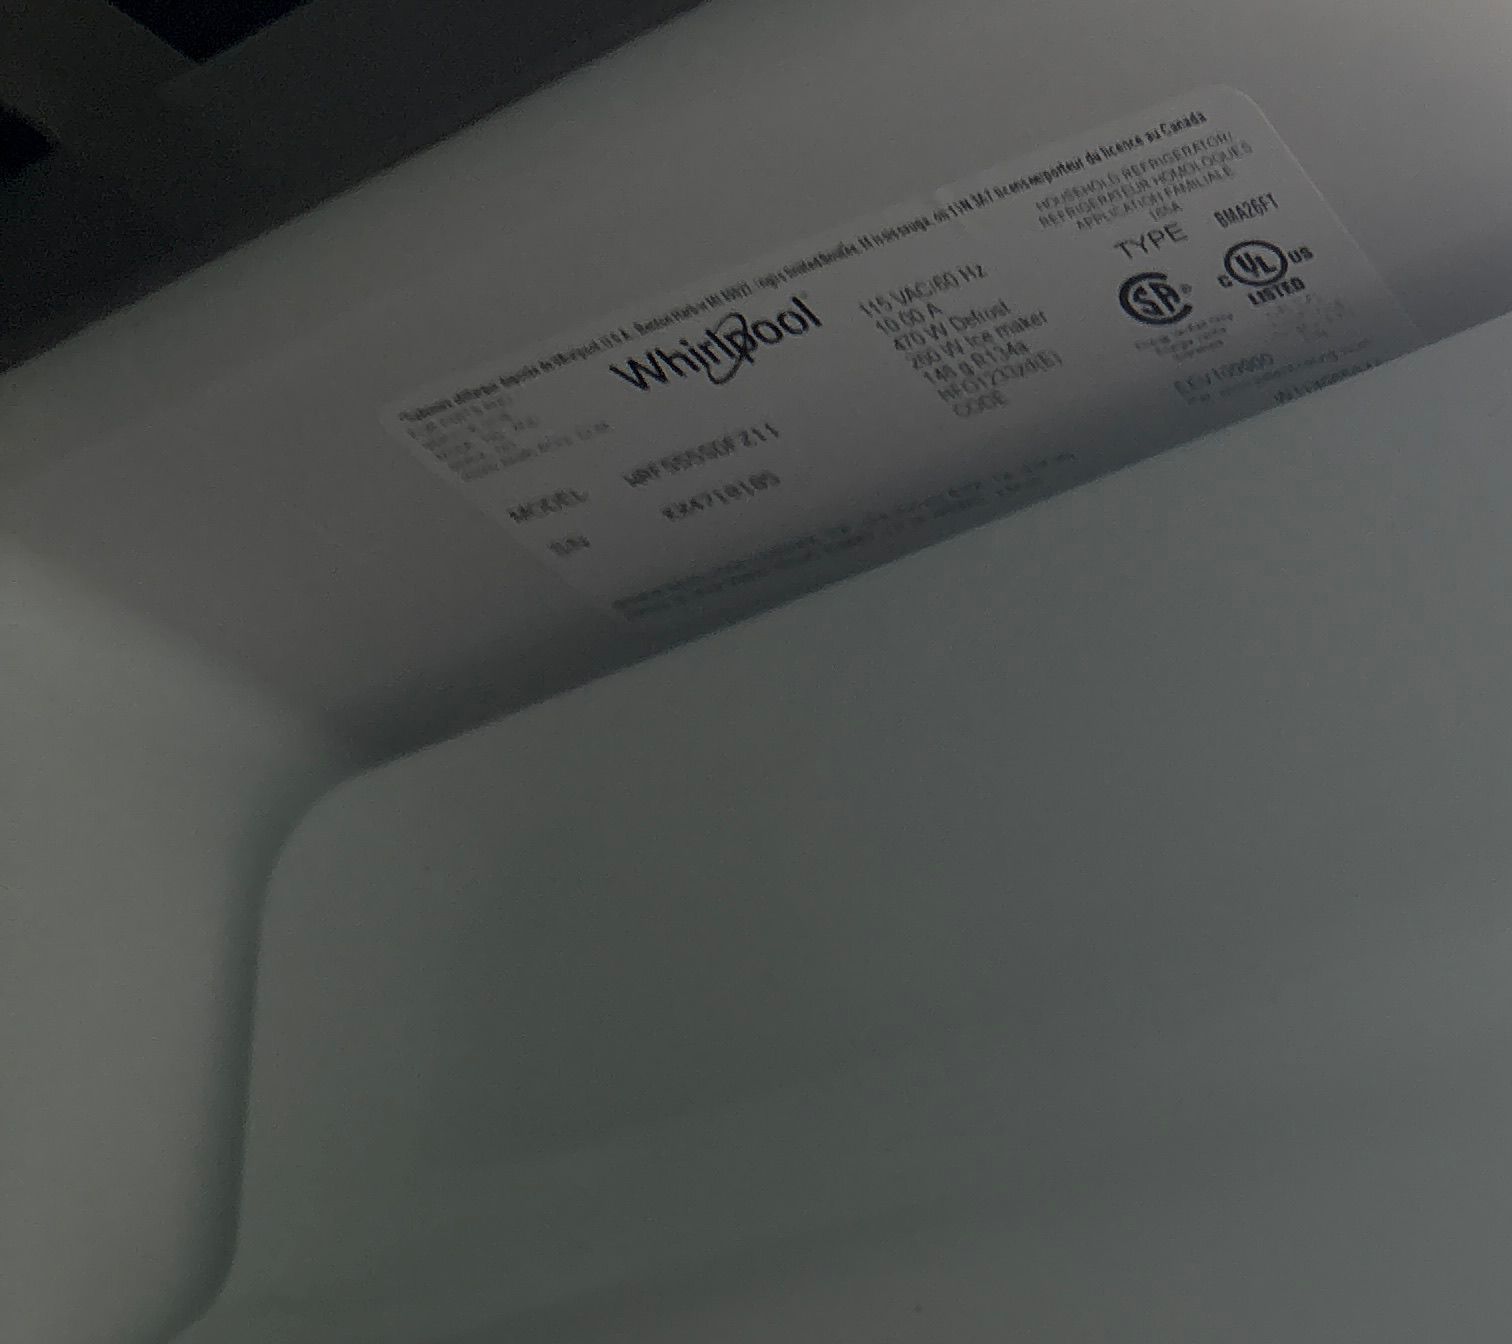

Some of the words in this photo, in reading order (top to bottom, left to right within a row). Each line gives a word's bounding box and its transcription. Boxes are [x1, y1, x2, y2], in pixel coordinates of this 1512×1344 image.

[1159, 111, 1207, 135] Canada
[1113, 222, 1188, 259] TYPE
[859, 296, 893, 318] 115
[957, 264, 985, 283] Hz
[926, 302, 943, 319] A
[948, 299, 1011, 332] Defrost
[995, 310, 1048, 338] maker
[610, 296, 822, 390] Whirlpool
